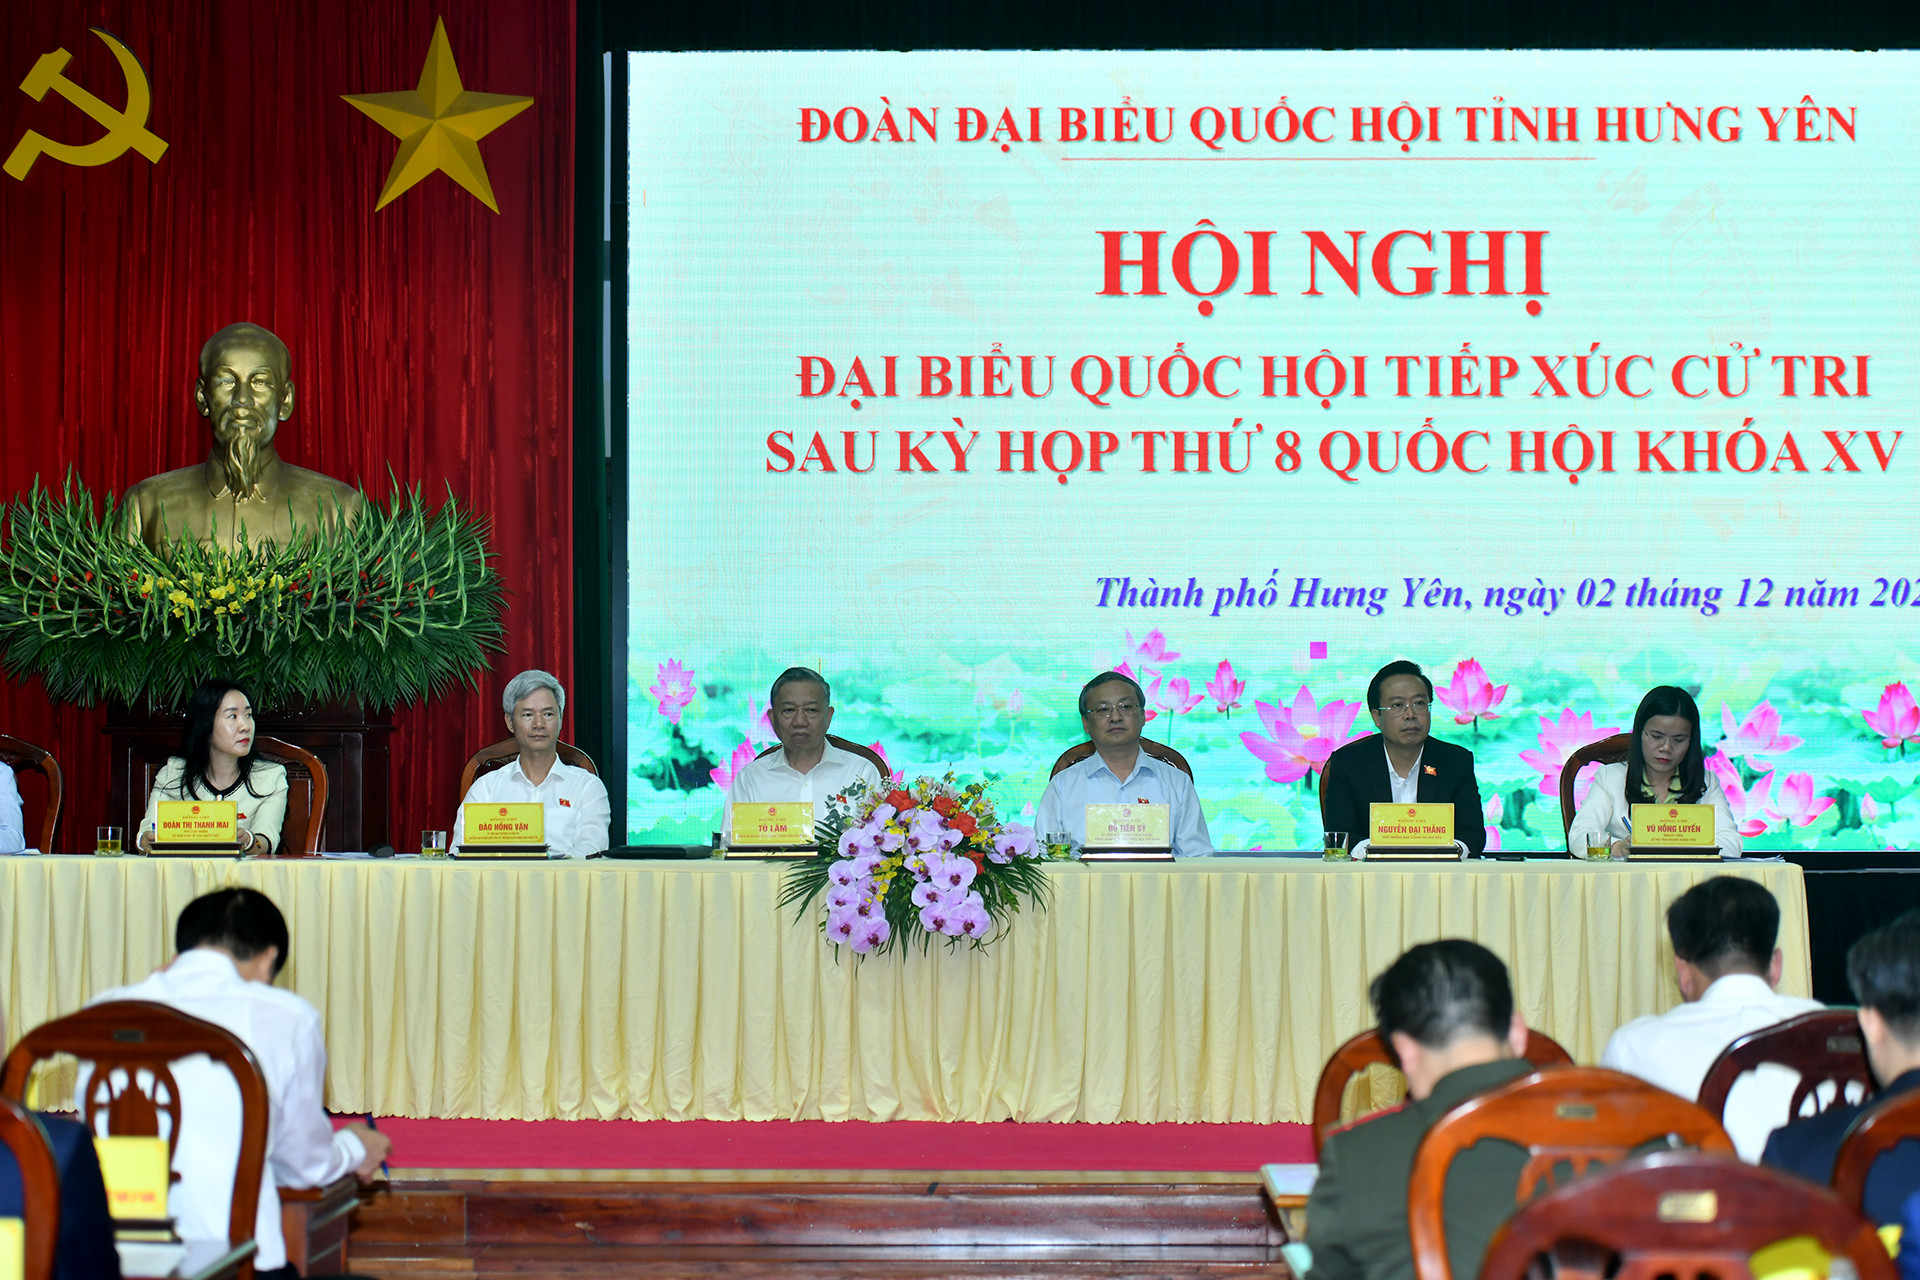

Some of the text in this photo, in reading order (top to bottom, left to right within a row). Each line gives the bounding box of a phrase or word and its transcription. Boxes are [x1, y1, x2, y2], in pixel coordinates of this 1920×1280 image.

[797, 96, 1857, 152] ĐOÀN ĐẠI BIỂU QUỐC HỘI TỈNH HƯNG YÊN
[1096, 219, 1550, 316] HỘI NGHỊ
[796, 342, 1871, 410] ĐẠI BIỂU QUỐC HỘI TIẾP XÚC CỬ TRI
[767, 418, 1903, 485] SAU KỲ HỌP THỨ 8 QUỐC HỘI KHÓA XV
[1096, 577, 1204, 608] Thành
[1210, 567, 1280, 617] phố
[1289, 578, 1389, 617] Hưng
[1403, 578, 1472, 613] Yên,
[1484, 578, 1566, 617] ngày
[1577, 578, 1616, 607] 02
[1625, 577, 1724, 617] tháng
[1737, 578, 1774, 607] 12
[1785, 578, 1859, 607] năm
[182, 821, 192, 830] THỊ
[194, 821, 215, 829] THANH
[216, 821, 229, 829] MAI
[479, 822, 492, 831] ĐÀO
[515, 822, 529, 832] VẬN
[758, 823, 787, 832] TÔ LÂM
[1408, 825, 1421, 835] ĐẠI
[1646, 823, 1656, 832] VŨ
